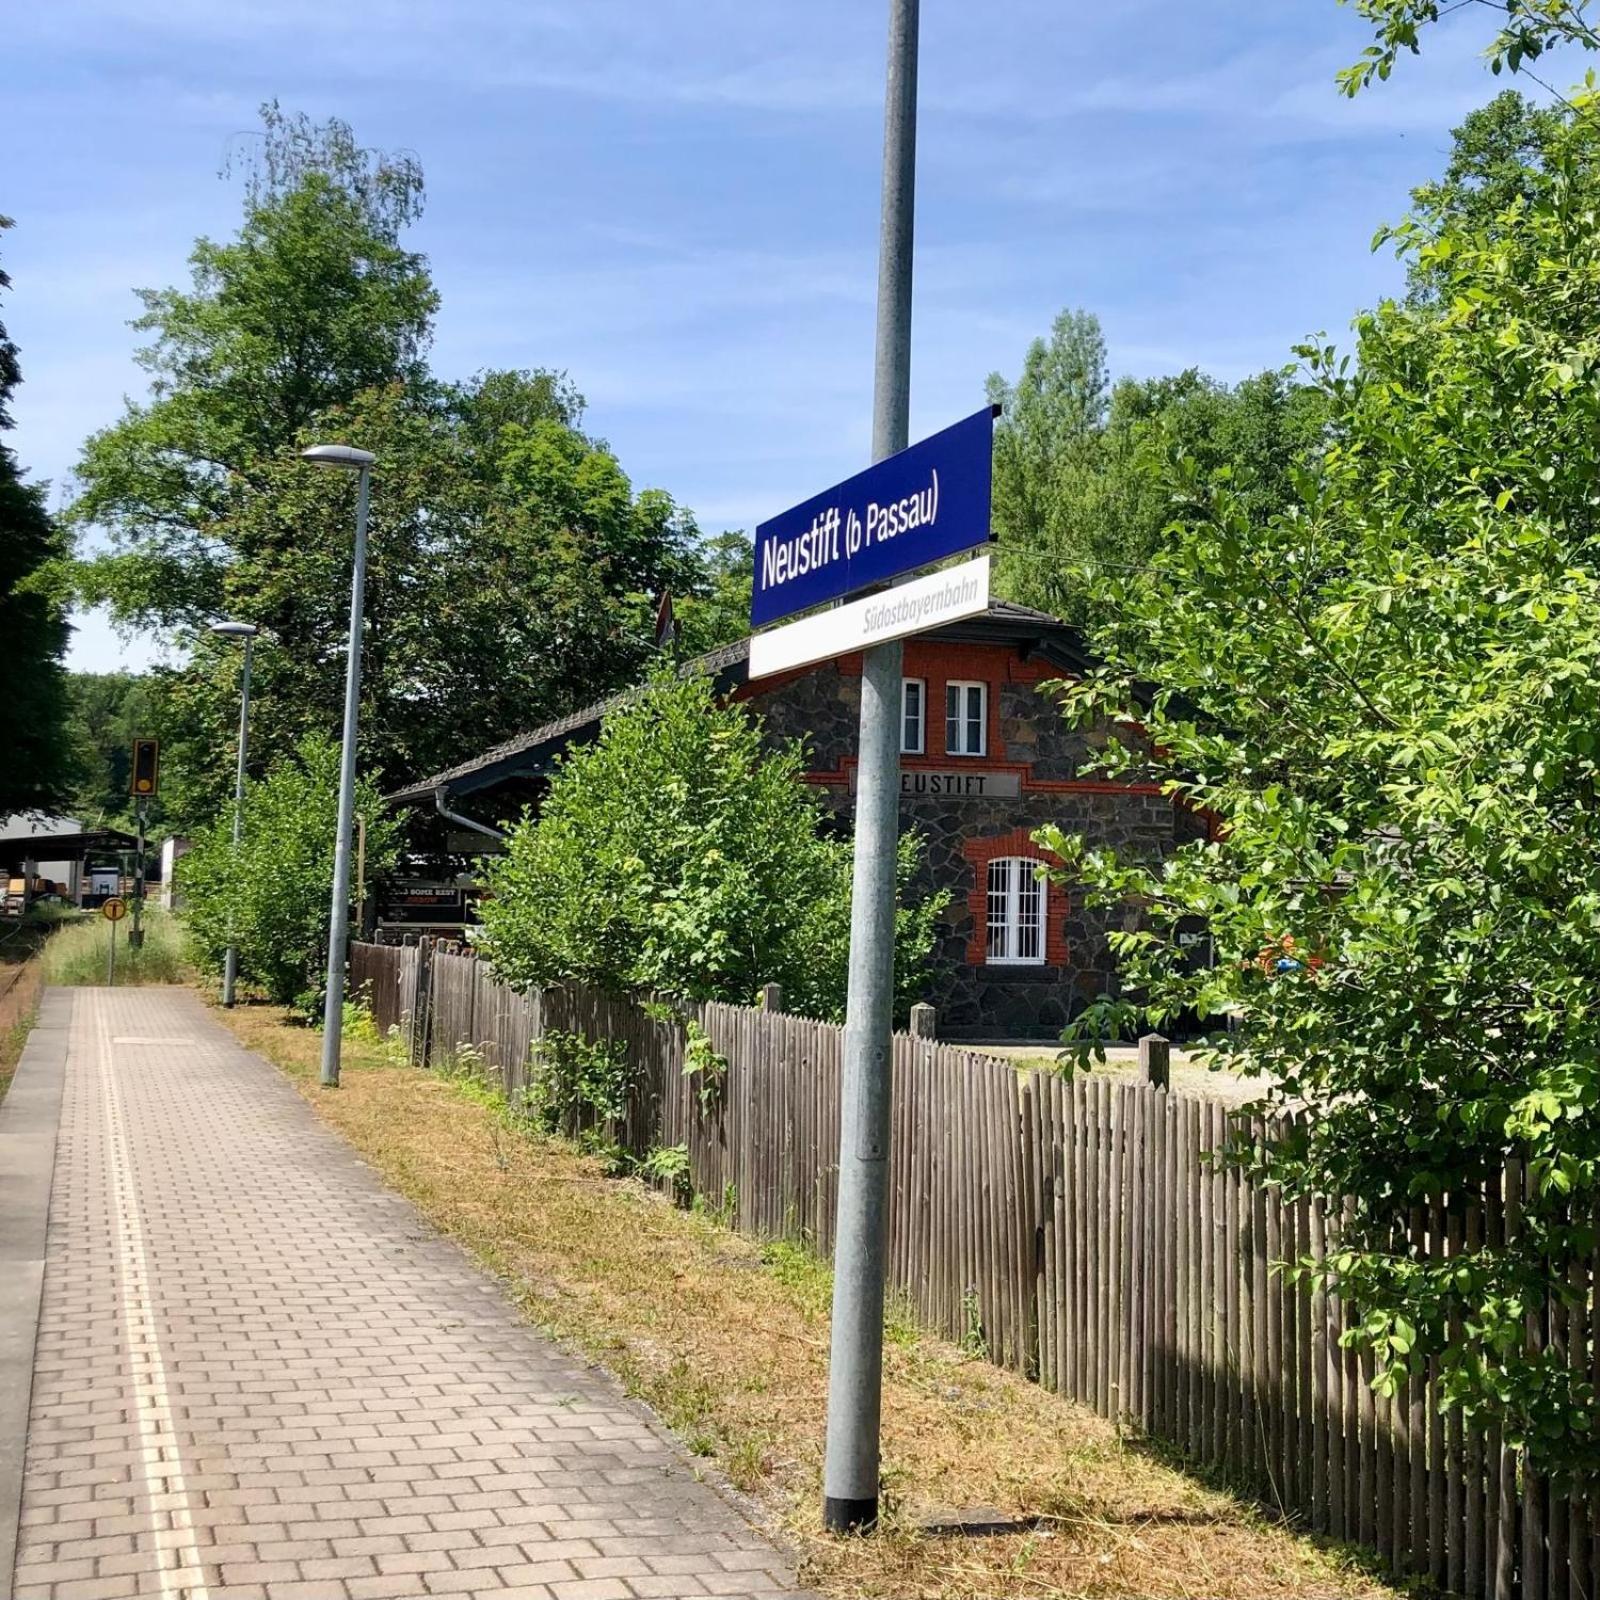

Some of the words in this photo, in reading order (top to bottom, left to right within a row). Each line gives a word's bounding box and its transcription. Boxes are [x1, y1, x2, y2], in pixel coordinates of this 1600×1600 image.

[761, 507, 841, 591] Neustift
[845, 508, 862, 560] (b
[865, 468, 939, 547] Passau)
[863, 575, 978, 634] Südostbayernbahn
[900, 773, 987, 794] EUSTIFT
